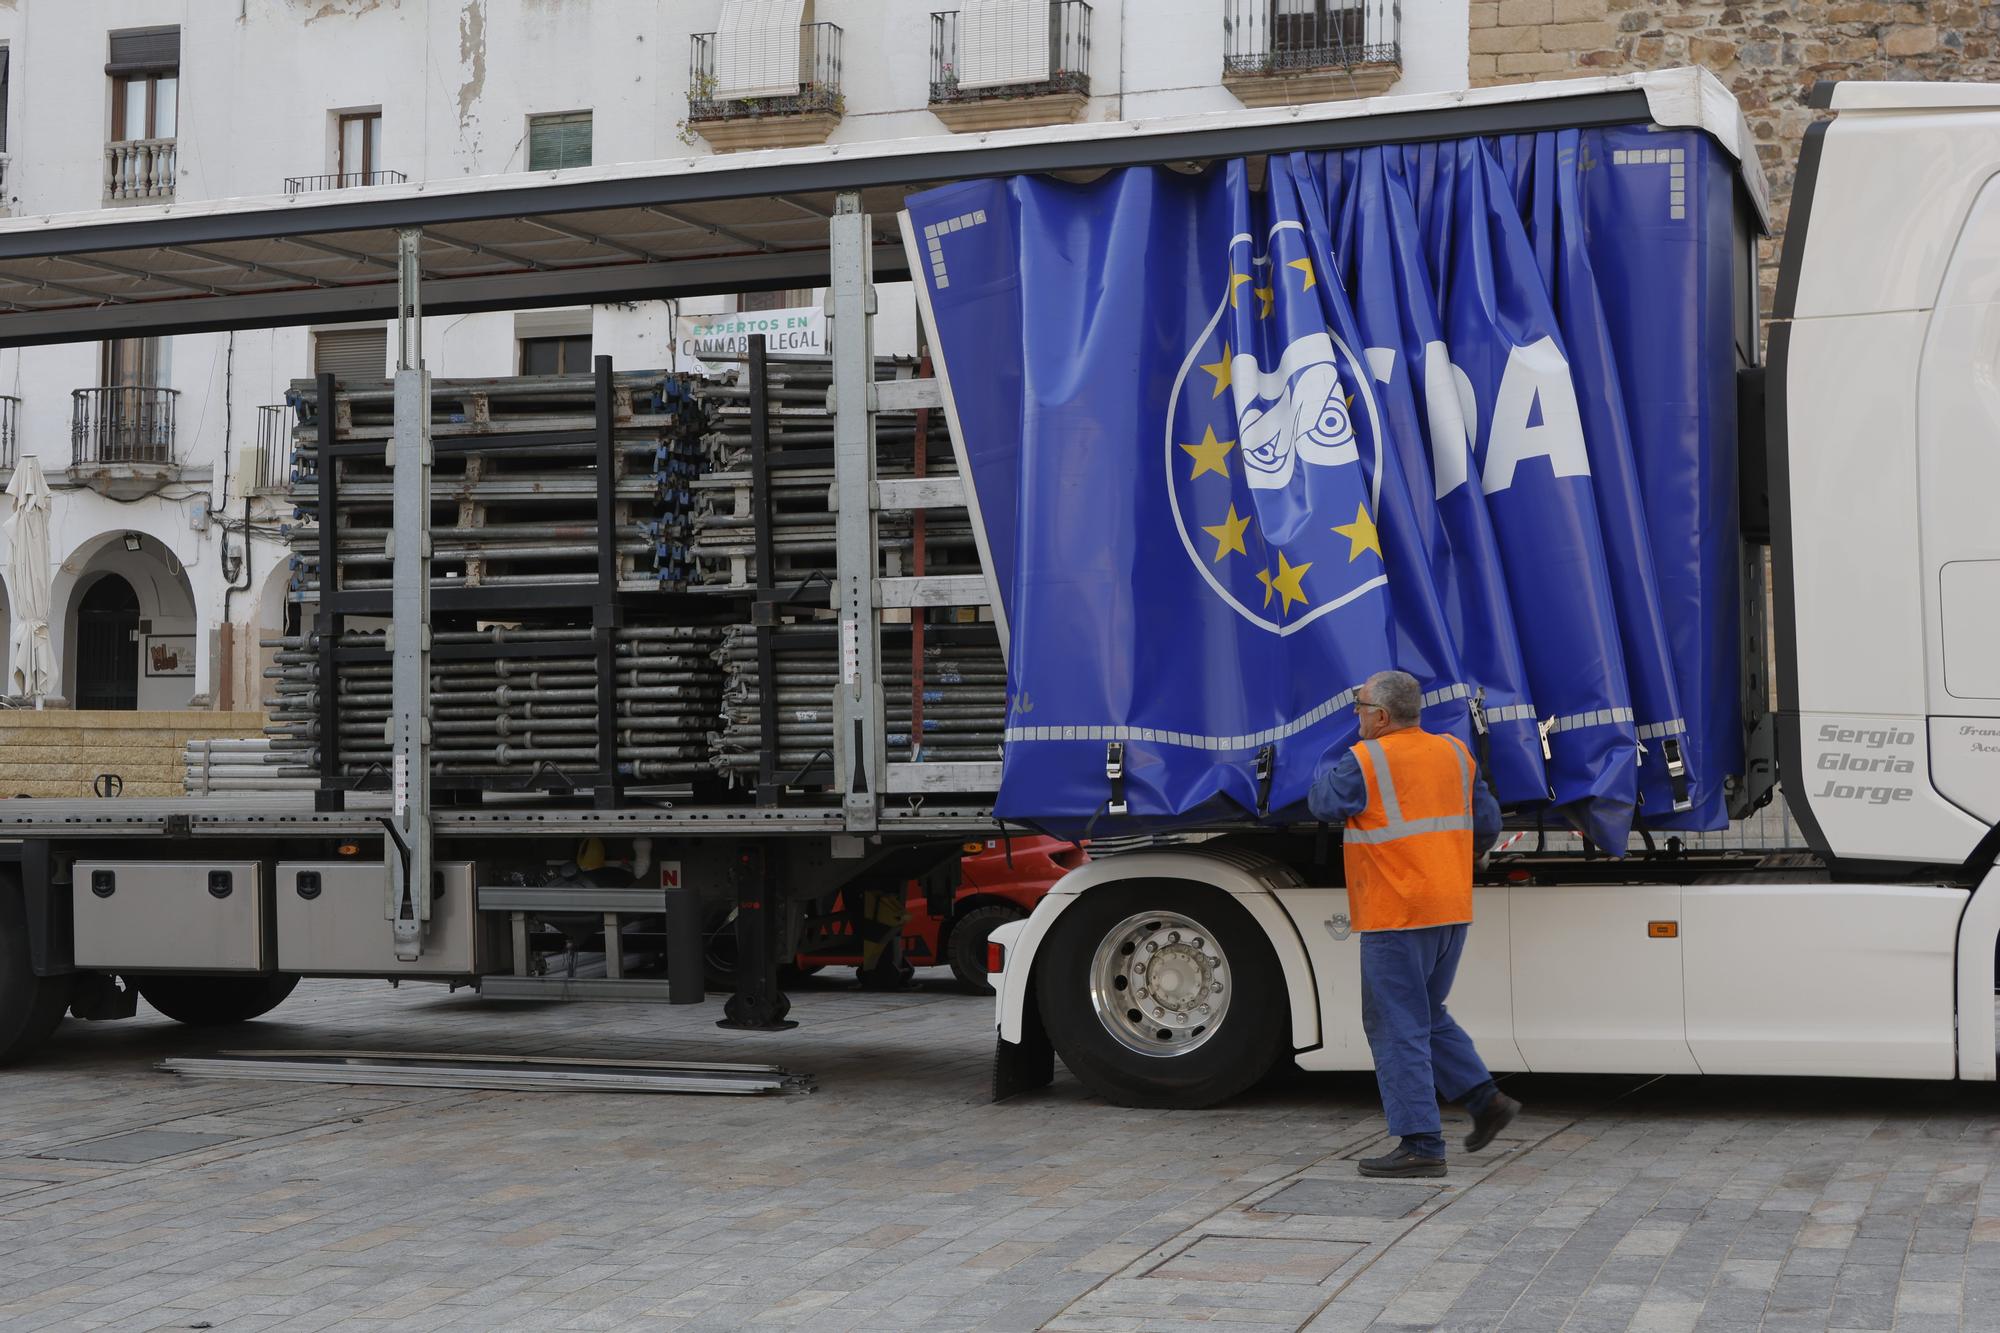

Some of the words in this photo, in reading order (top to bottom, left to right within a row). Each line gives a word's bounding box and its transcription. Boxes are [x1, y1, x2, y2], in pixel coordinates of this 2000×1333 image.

[692, 318, 780, 336] EXPERTOS
[787, 316, 808, 329] EN
[769, 331, 820, 351] LEGAL
[1817, 724, 1915, 749] Sergio
[1816, 752, 1915, 774] Gloria
[1813, 780, 1914, 805] Jorge
[662, 870, 678, 886] N
